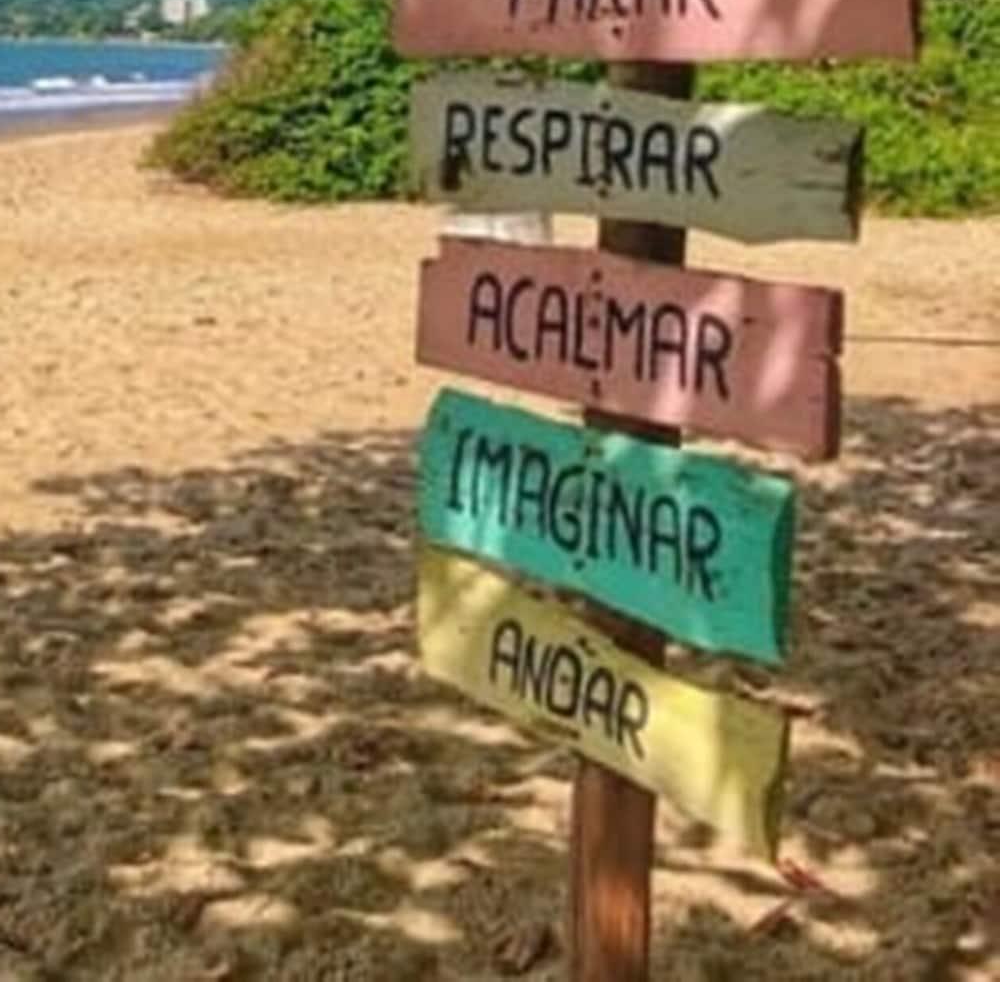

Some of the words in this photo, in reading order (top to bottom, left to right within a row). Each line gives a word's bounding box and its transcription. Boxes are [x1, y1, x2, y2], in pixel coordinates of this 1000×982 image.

[443, 102, 721, 200] RESPIRAR
[466, 271, 732, 402] ACALMAR
[442, 425, 722, 603] IMAGINAR
[488, 618, 650, 760] ANDAR
